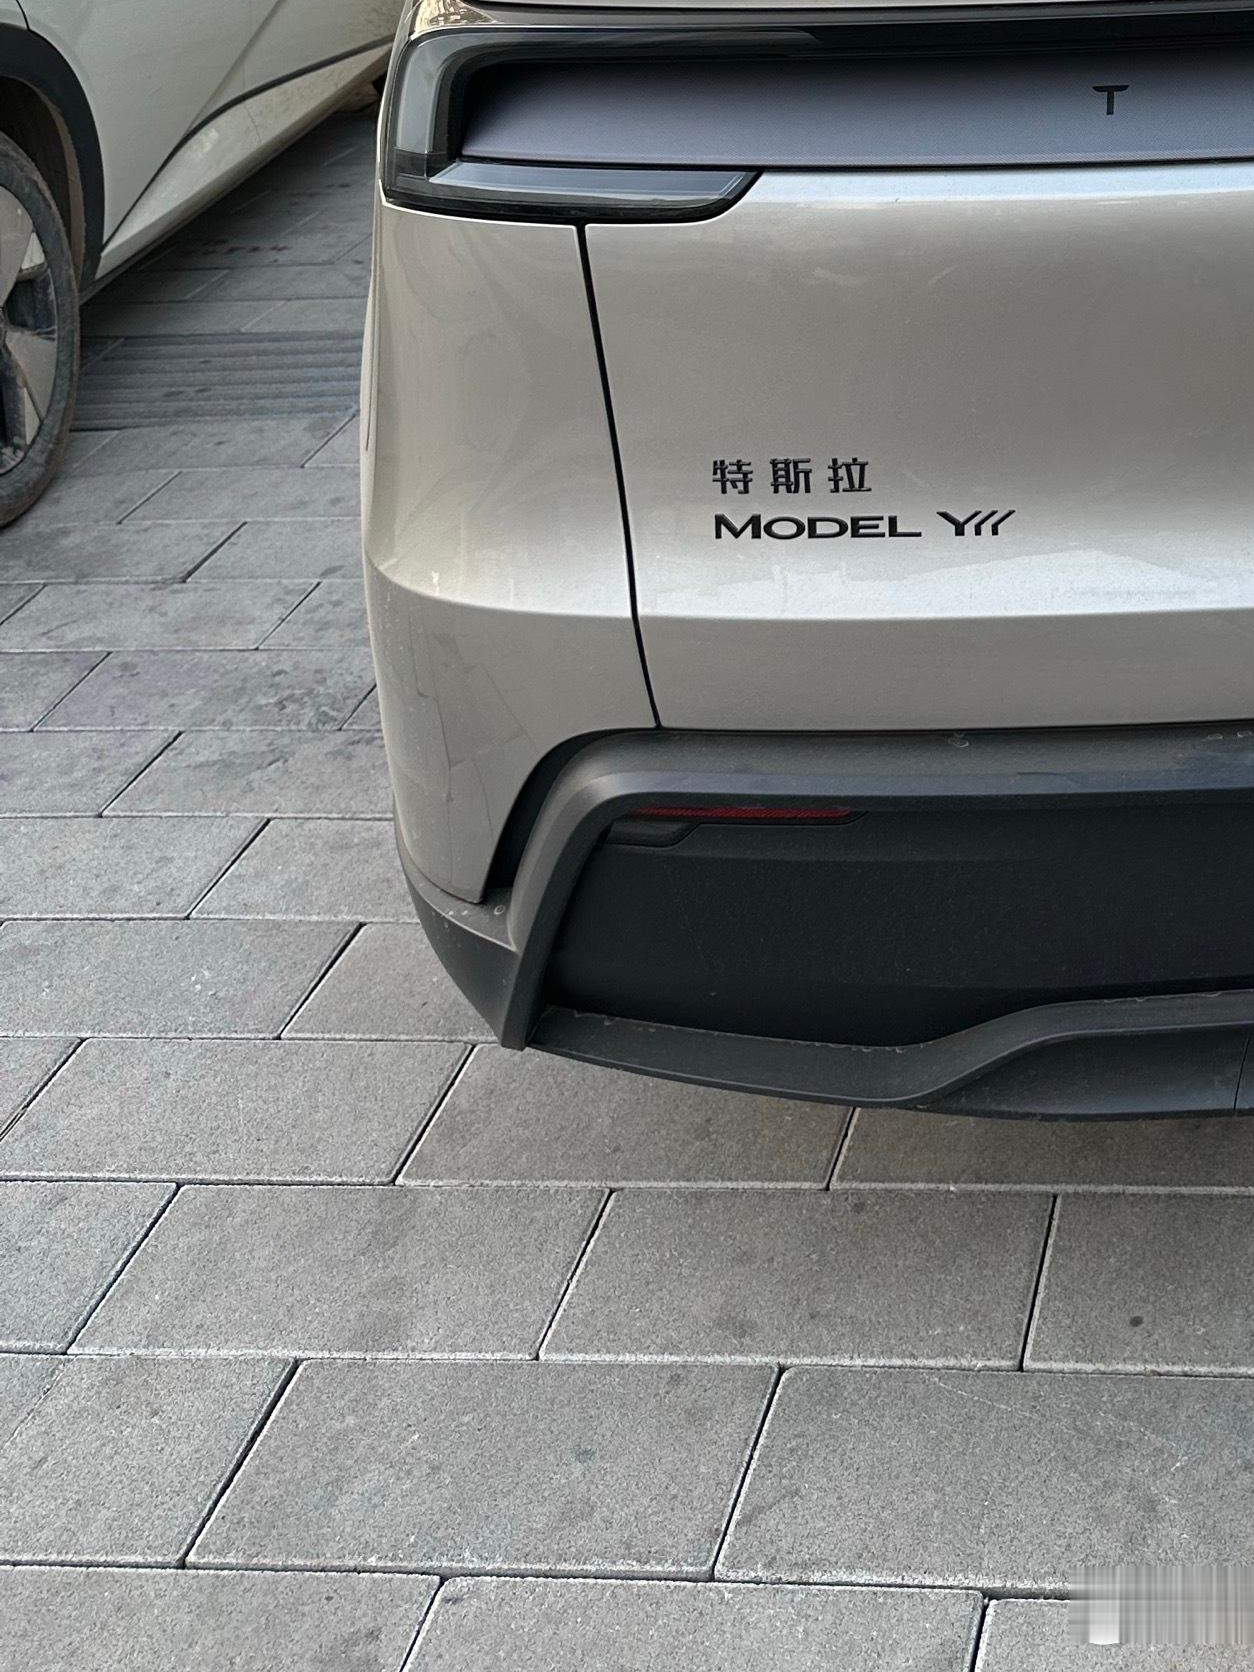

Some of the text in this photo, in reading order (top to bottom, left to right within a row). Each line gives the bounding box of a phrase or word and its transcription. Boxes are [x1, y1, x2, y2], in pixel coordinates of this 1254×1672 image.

[712, 457, 872, 495] 特斯拉
[714, 513, 922, 540] MODEL
